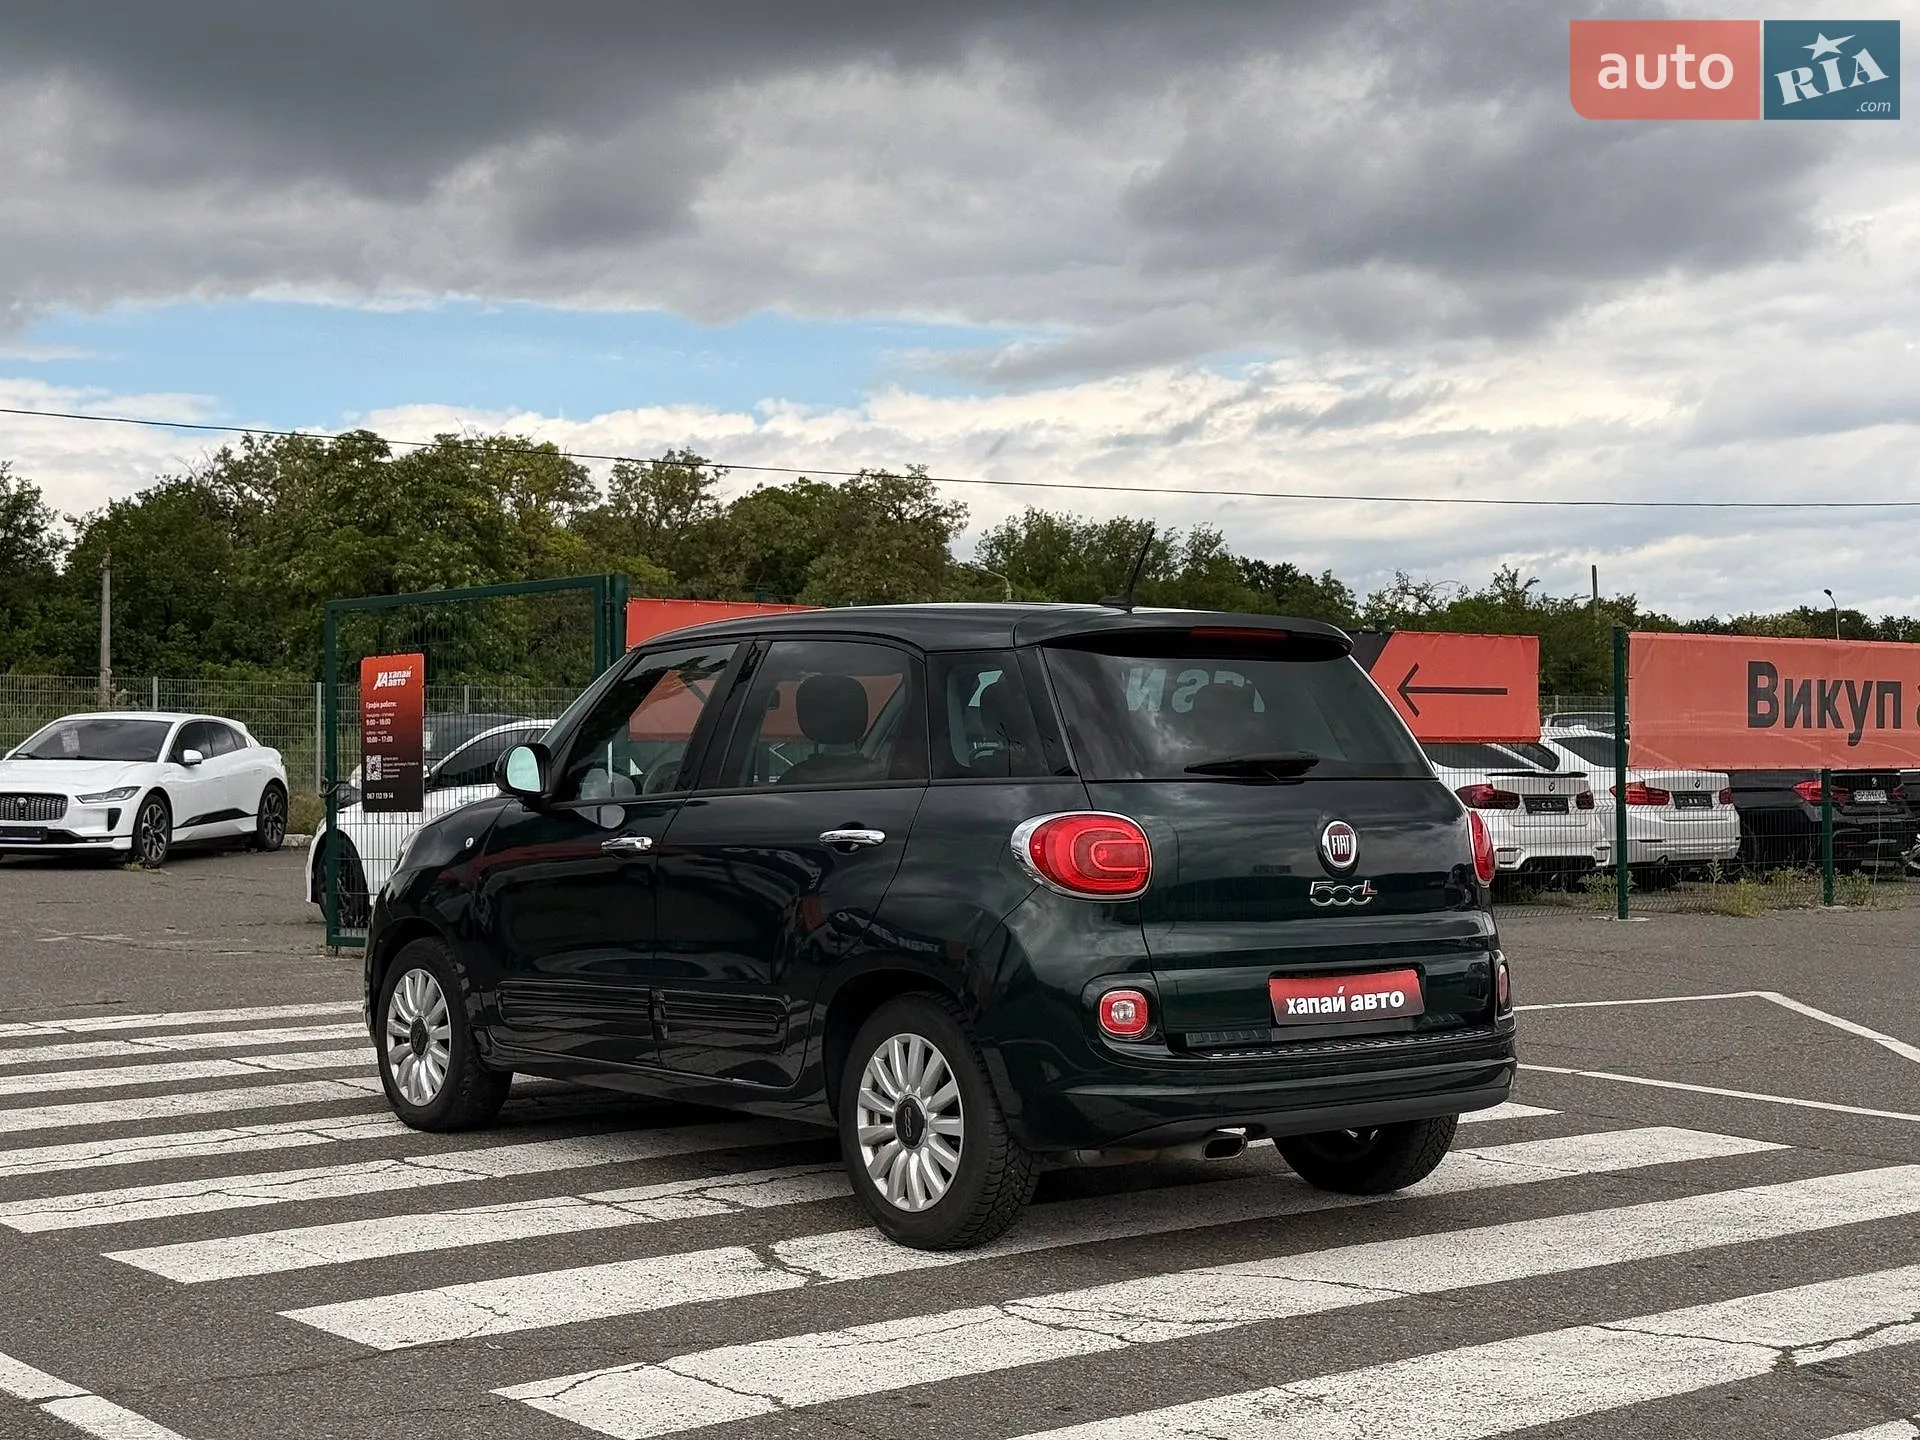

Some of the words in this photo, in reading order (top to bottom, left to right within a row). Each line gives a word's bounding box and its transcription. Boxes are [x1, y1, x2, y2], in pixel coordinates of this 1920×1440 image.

[1747, 661, 1902, 747] Викуп
[1332, 834, 1350, 855] FIAT
[1285, 986, 1346, 1015] хапай
[1350, 990, 1405, 1012] авто
